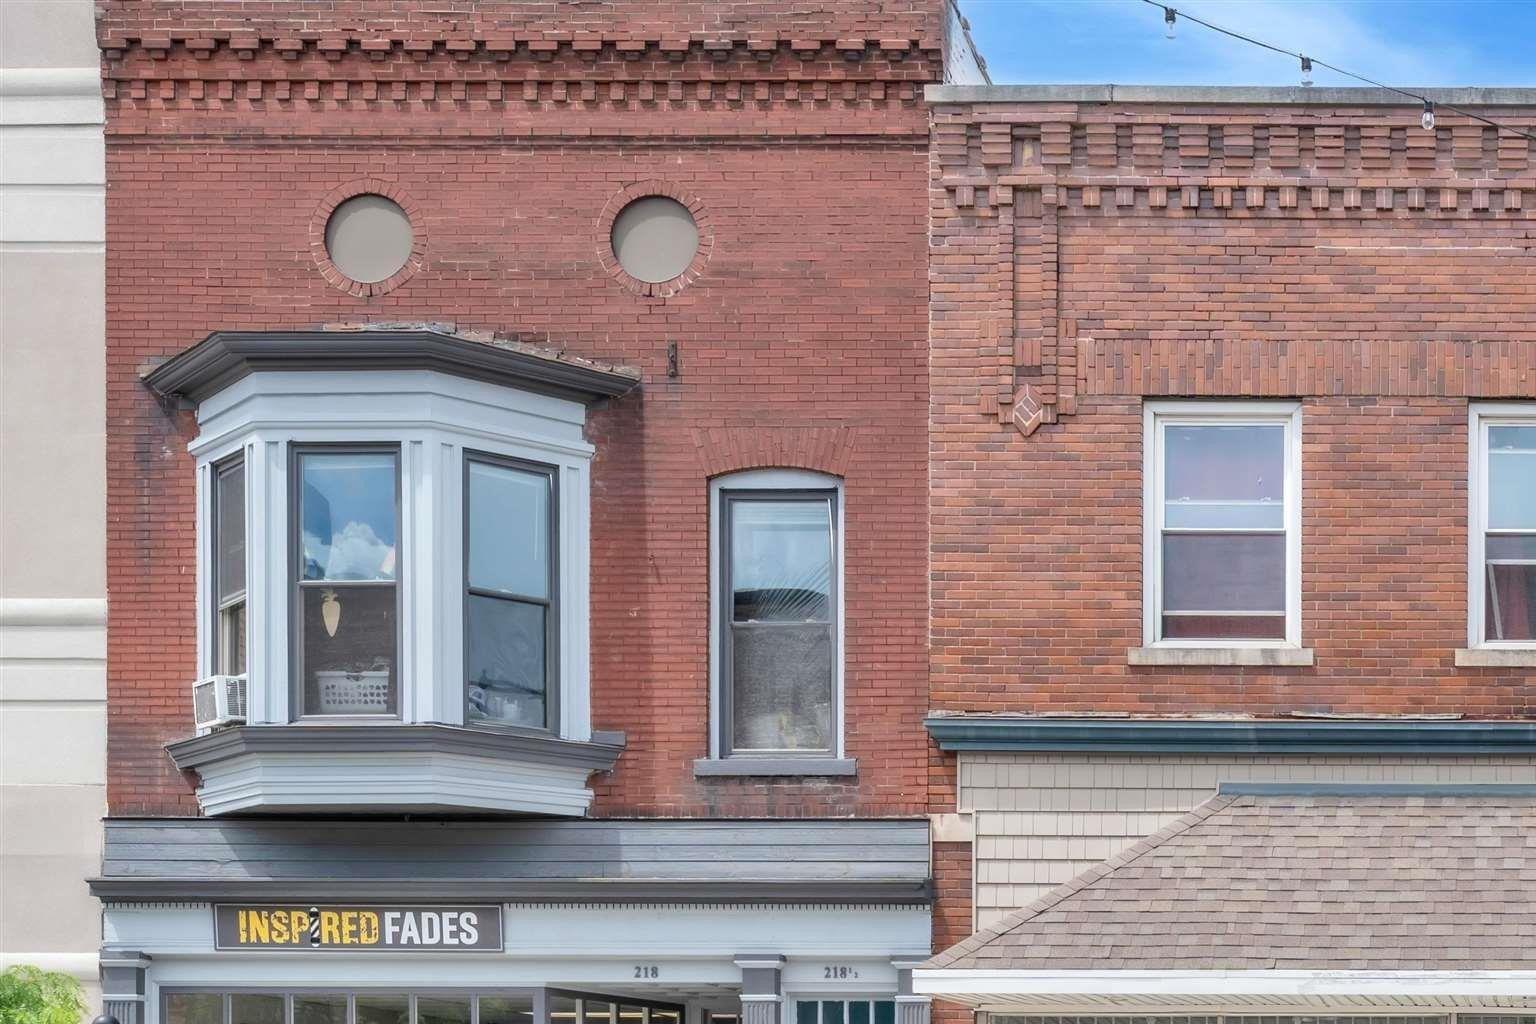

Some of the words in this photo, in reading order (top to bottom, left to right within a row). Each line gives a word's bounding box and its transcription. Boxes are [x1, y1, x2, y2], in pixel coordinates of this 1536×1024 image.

[238, 908, 379, 947] INSPIRED
[384, 911, 479, 945] FADES
[633, 966, 659, 979] 218
